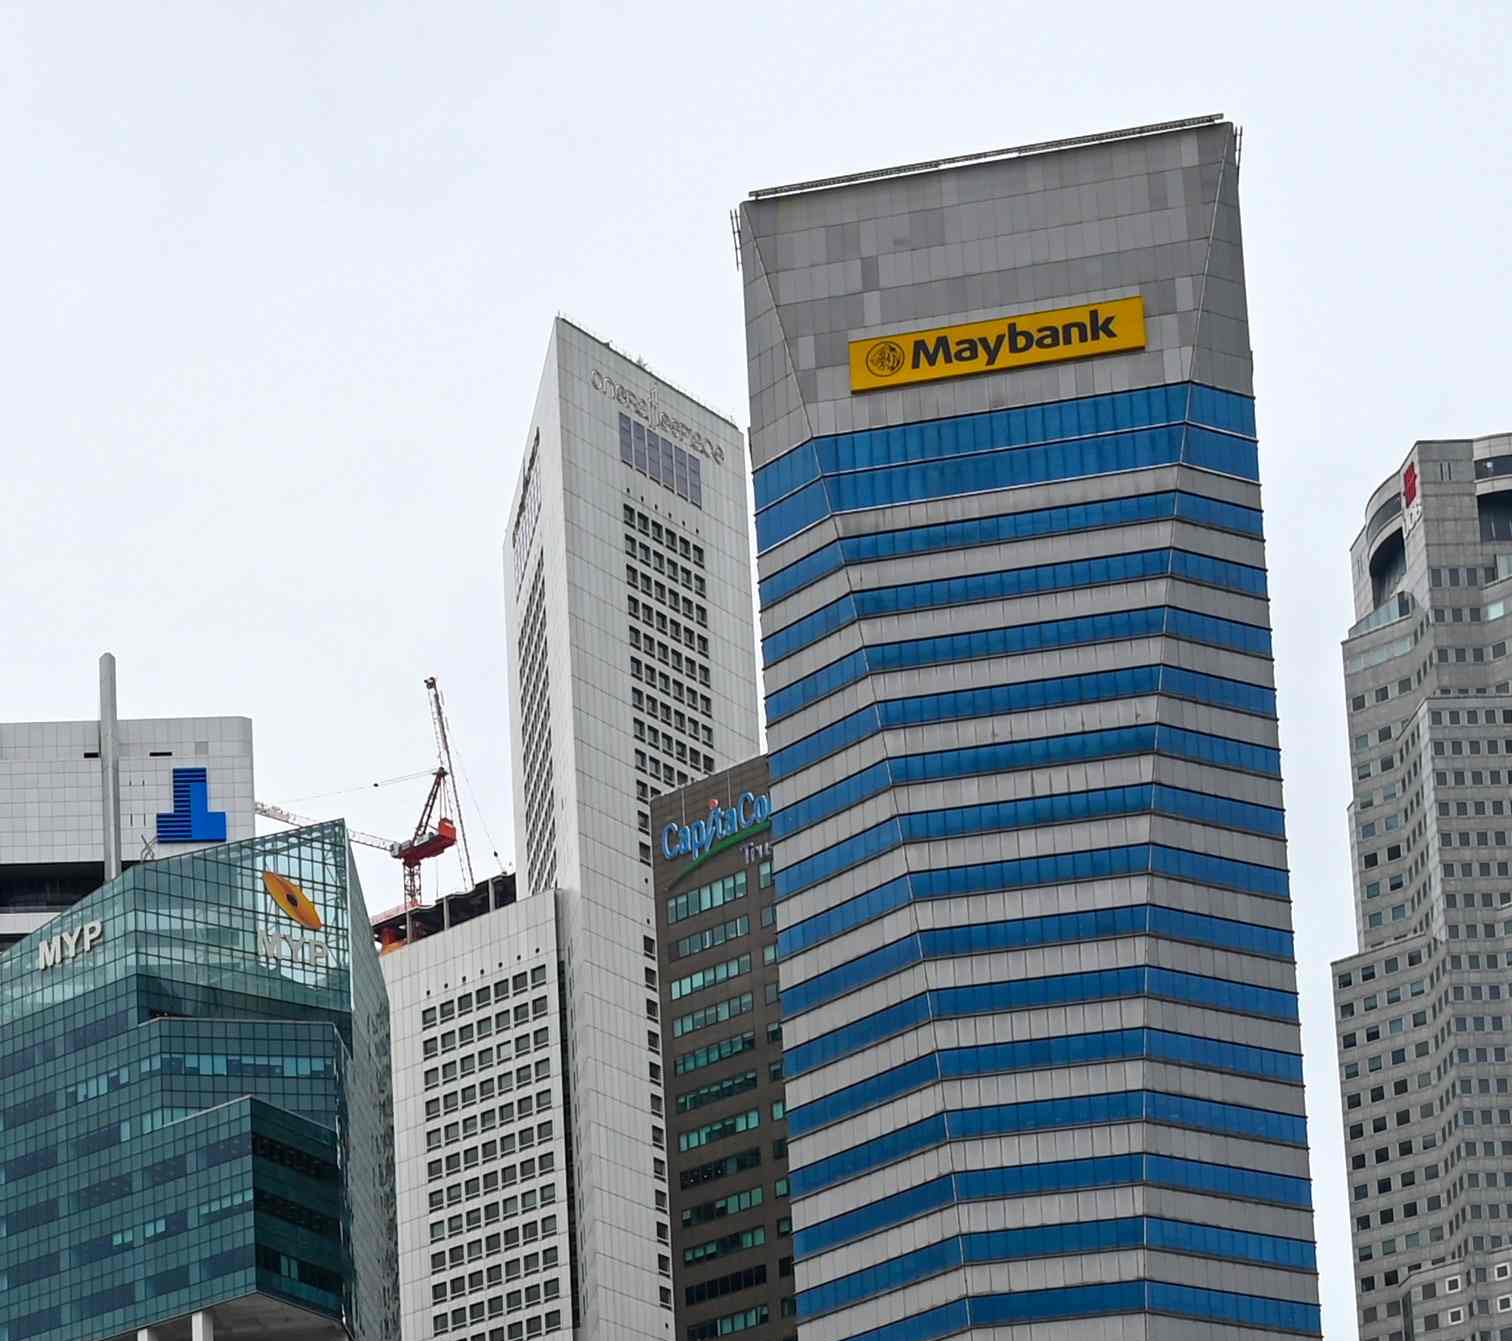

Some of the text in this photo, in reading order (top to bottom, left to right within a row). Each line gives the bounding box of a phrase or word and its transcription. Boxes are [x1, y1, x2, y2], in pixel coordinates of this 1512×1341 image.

[911, 308, 1118, 369] Maybank
[38, 920, 104, 970] MYP
[256, 926, 328, 967] MYP
